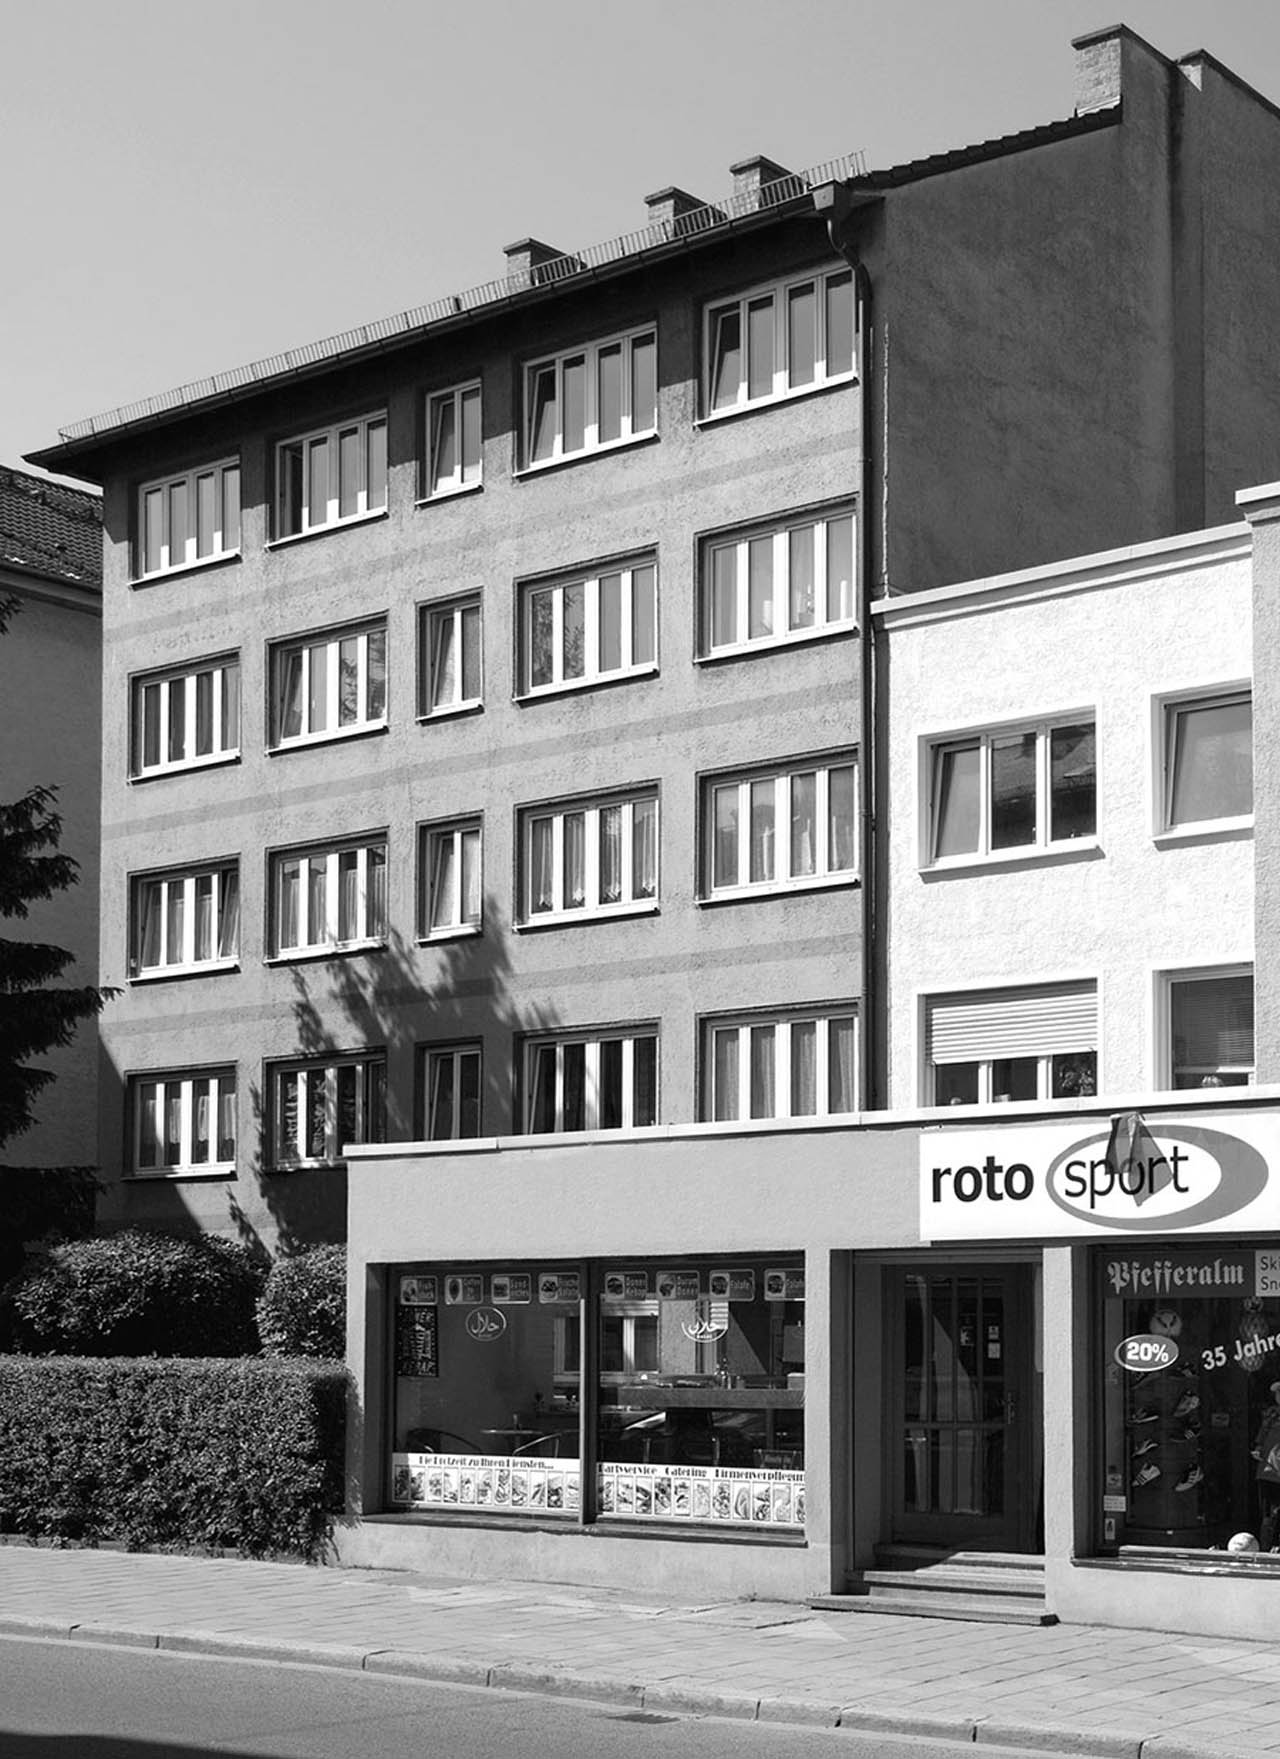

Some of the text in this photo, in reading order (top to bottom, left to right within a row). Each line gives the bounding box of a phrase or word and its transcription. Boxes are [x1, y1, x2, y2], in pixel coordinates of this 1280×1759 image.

[932, 1146, 1189, 1209] roto sport
[1107, 1259, 1245, 1295] Pfefferalm
[1126, 1342, 1169, 1362] 20%
[1202, 1346, 1227, 1370] 35
[715, 1468, 805, 1482] Firmenverpflegun
